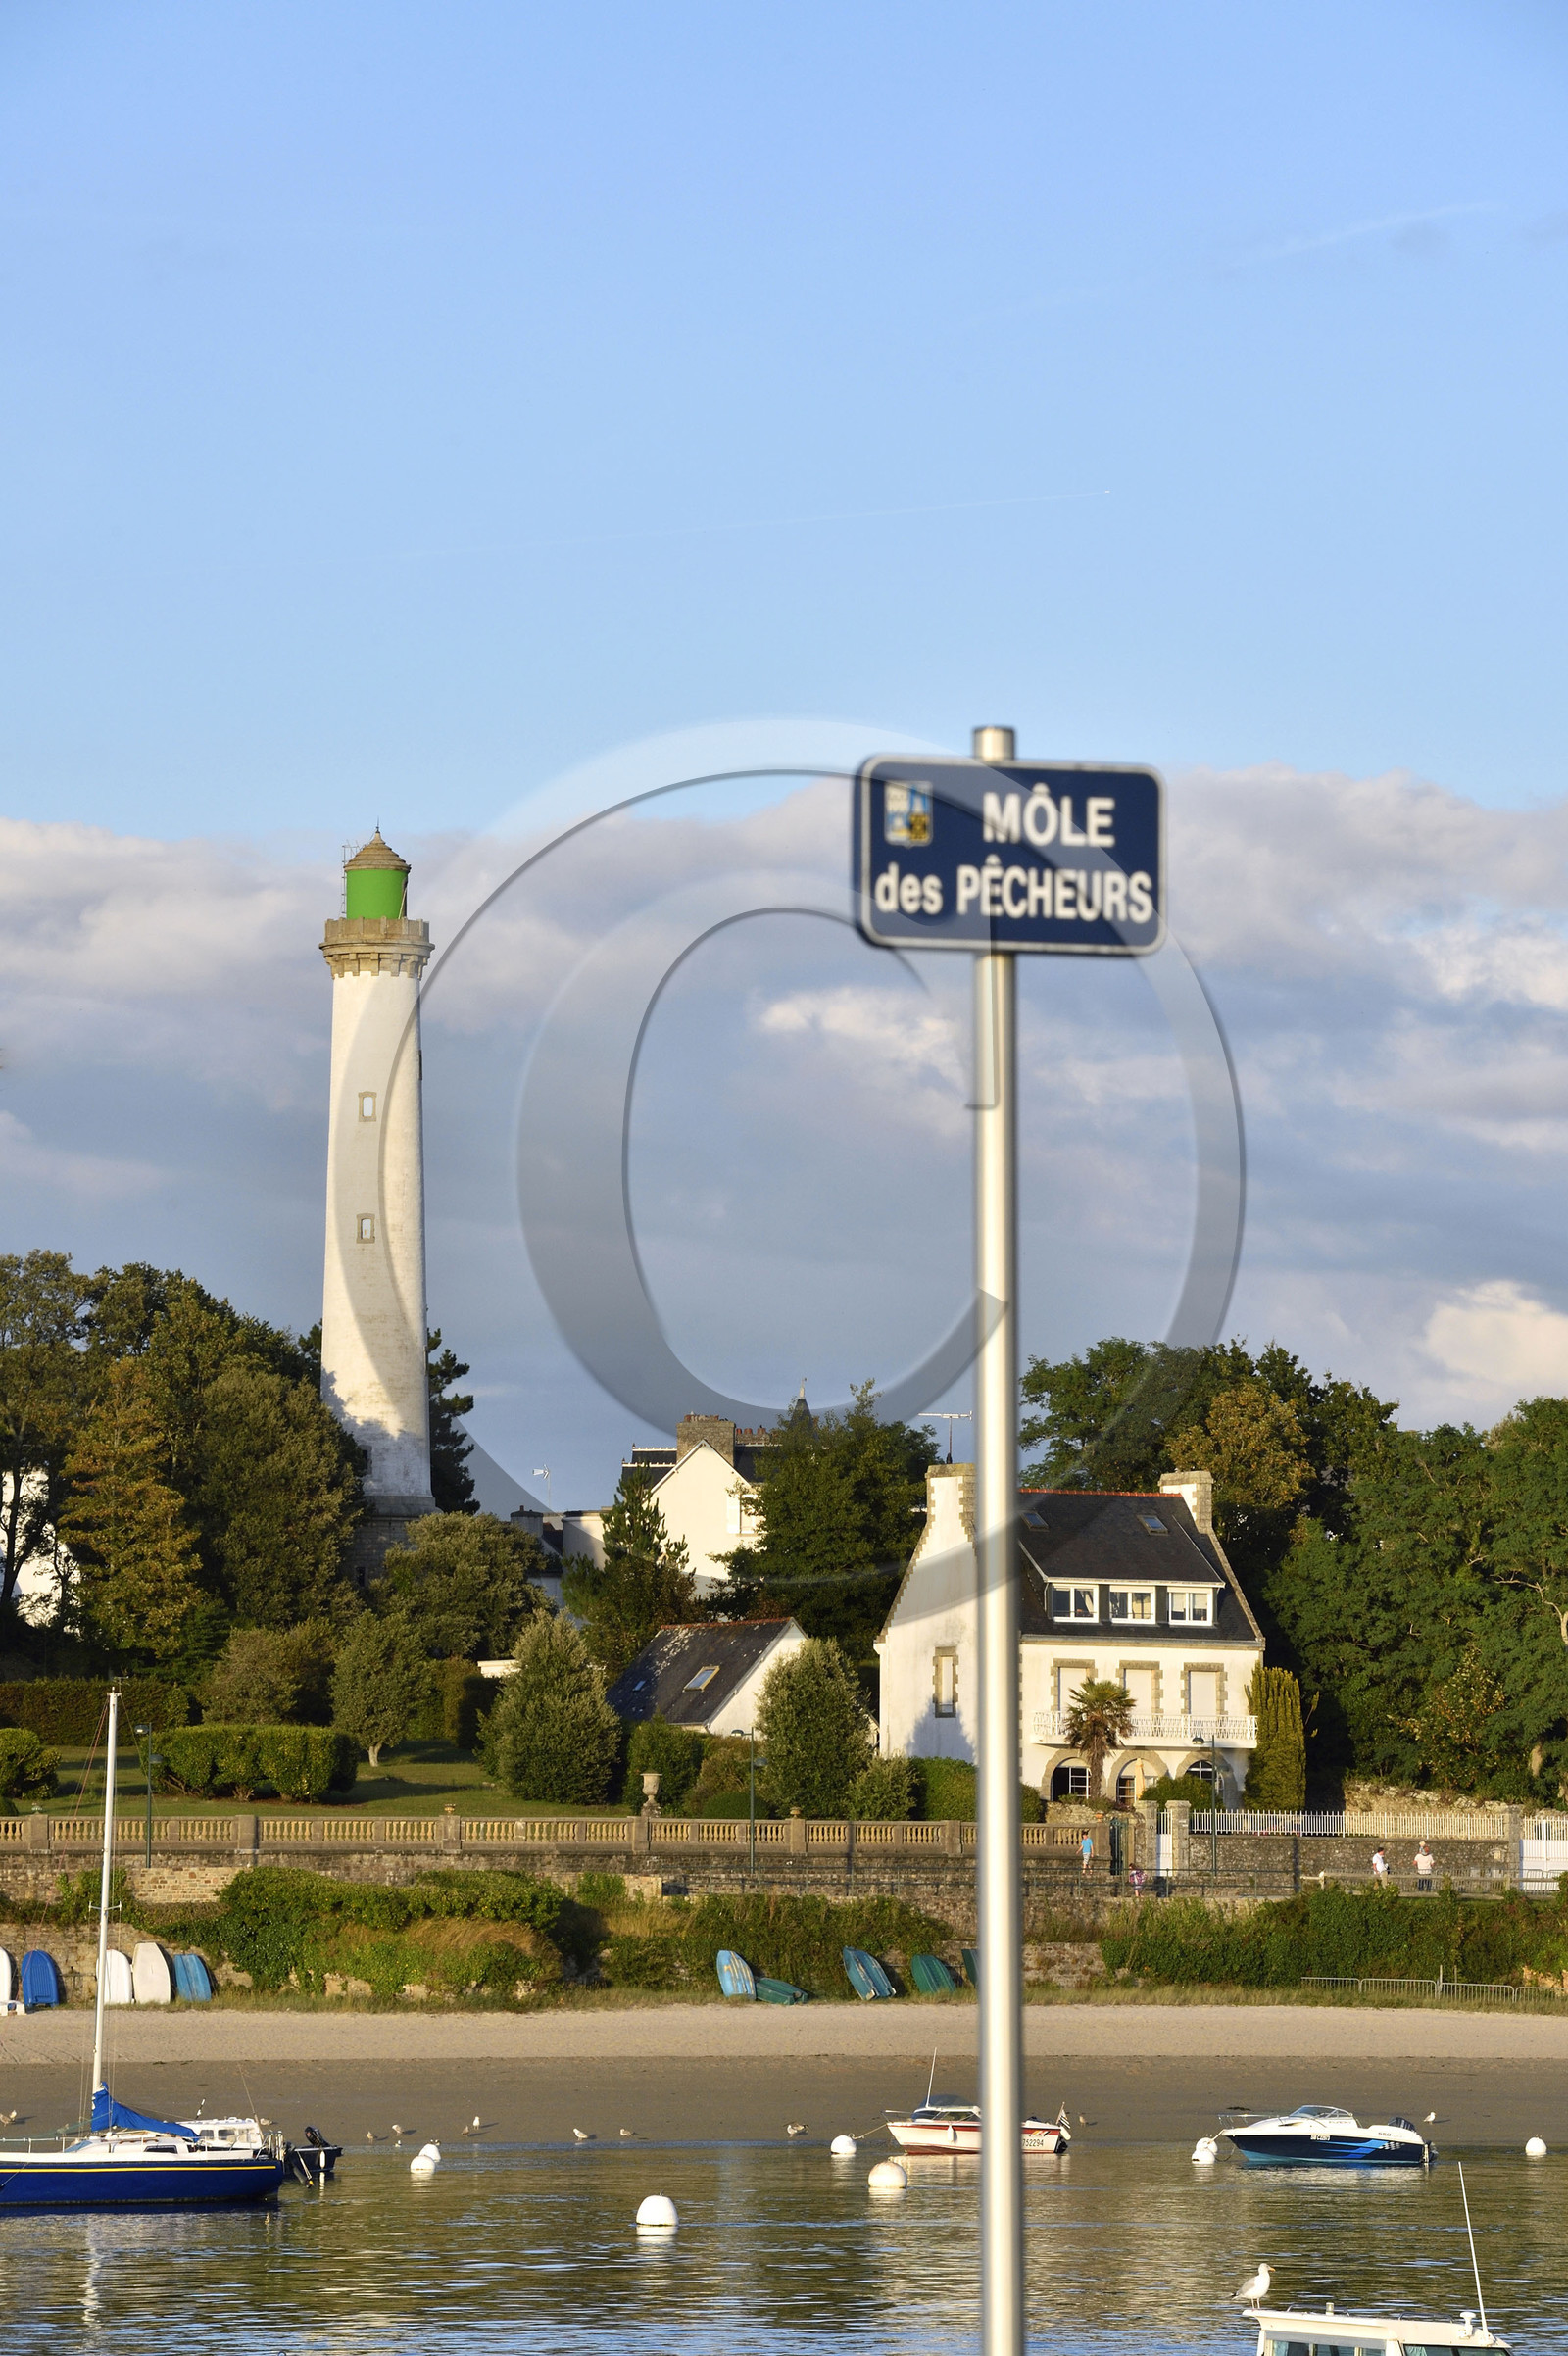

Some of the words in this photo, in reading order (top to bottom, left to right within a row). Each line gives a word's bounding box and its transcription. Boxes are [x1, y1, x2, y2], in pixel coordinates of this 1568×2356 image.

[983, 783, 1115, 848] MÔLE
[875, 862, 943, 915] des
[956, 854, 1153, 923] PÊCHEURS
